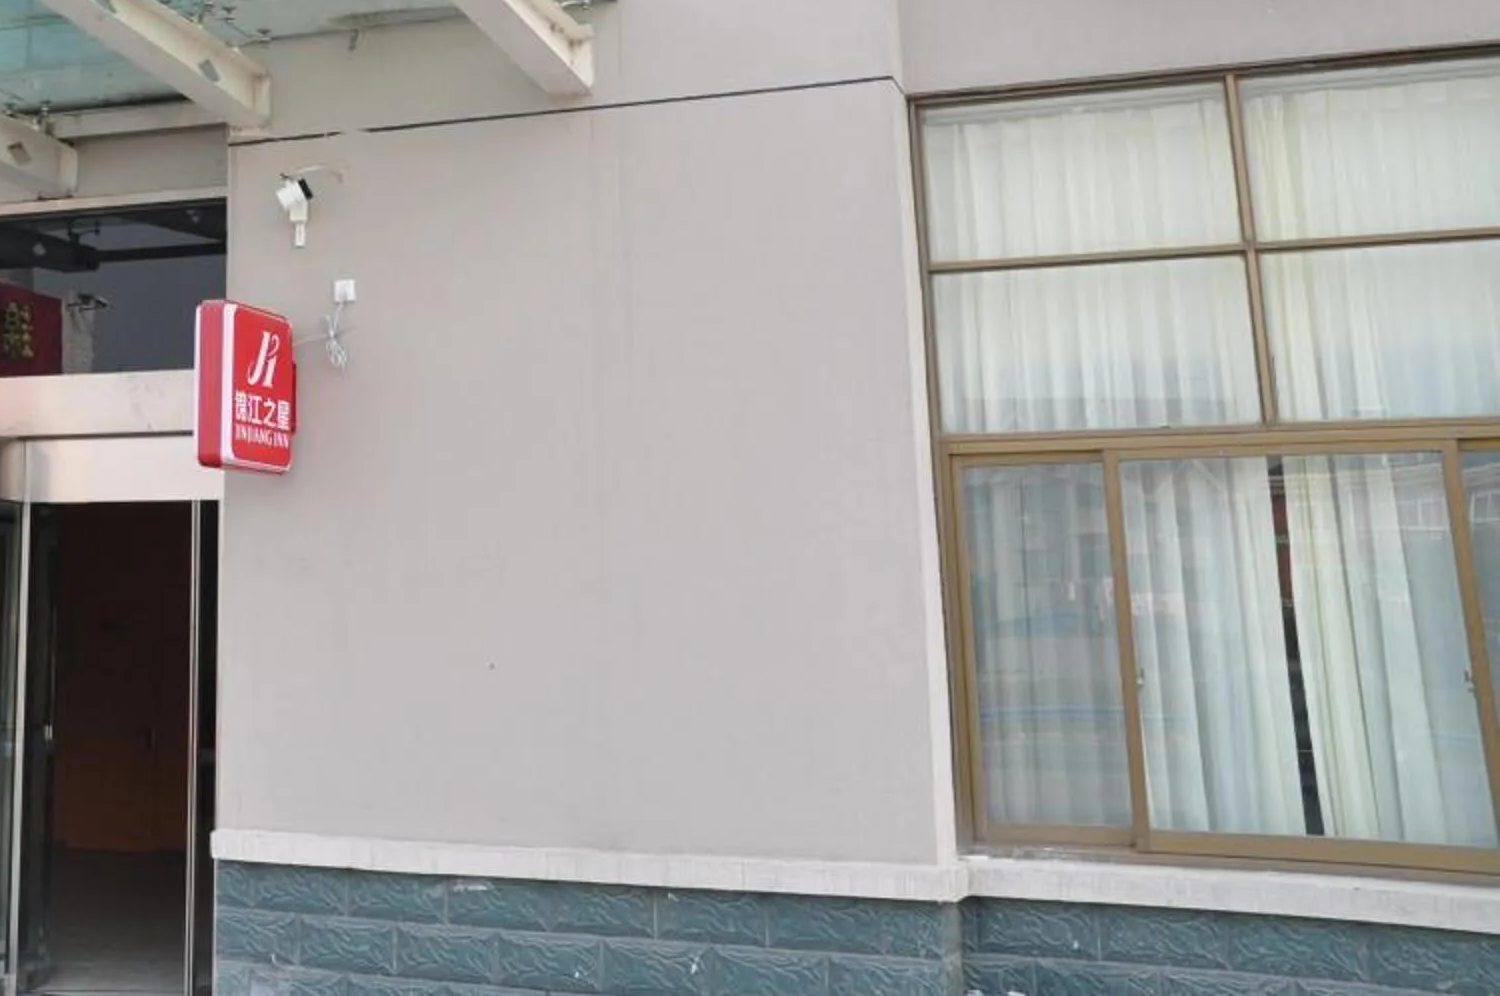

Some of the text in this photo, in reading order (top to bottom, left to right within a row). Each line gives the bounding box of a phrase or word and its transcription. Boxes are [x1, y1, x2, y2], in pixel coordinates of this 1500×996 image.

[234, 389, 291, 430] 锦江之星
[235, 422, 289, 449] JINJIANG INN
